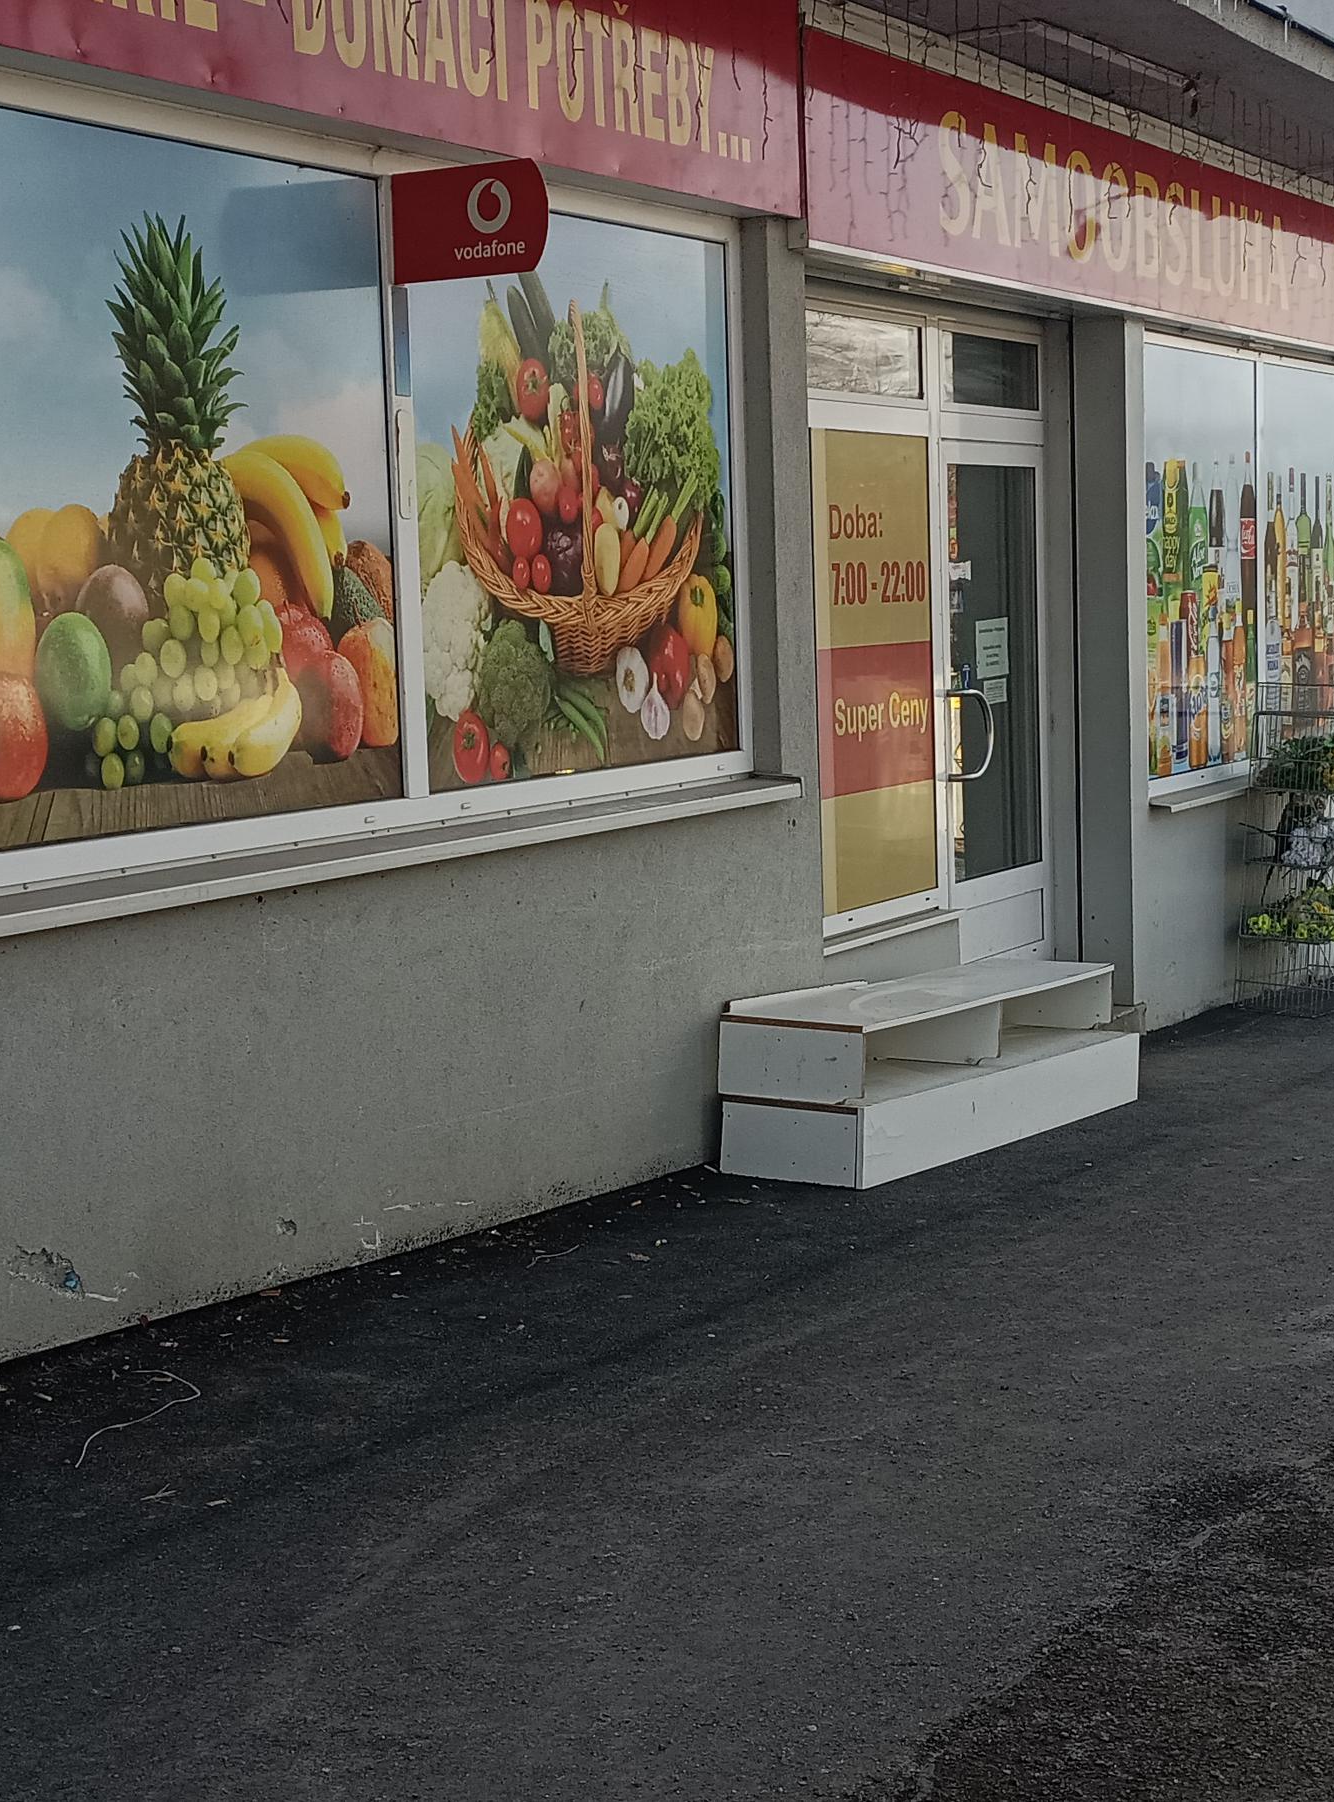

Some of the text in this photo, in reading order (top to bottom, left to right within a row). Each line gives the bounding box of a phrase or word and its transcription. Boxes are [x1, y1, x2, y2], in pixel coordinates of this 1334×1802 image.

[525, 0, 752, 163] POTŘEBY...
[938, 110, 1289, 310] SAMOOBSLUHA
[454, 240, 525, 260] vodafone
[829, 504, 883, 540] Doba:
[831, 562, 867, 606] 7:00
[881, 561, 926, 603] 22:00
[835, 691, 928, 742] Super Ceny
